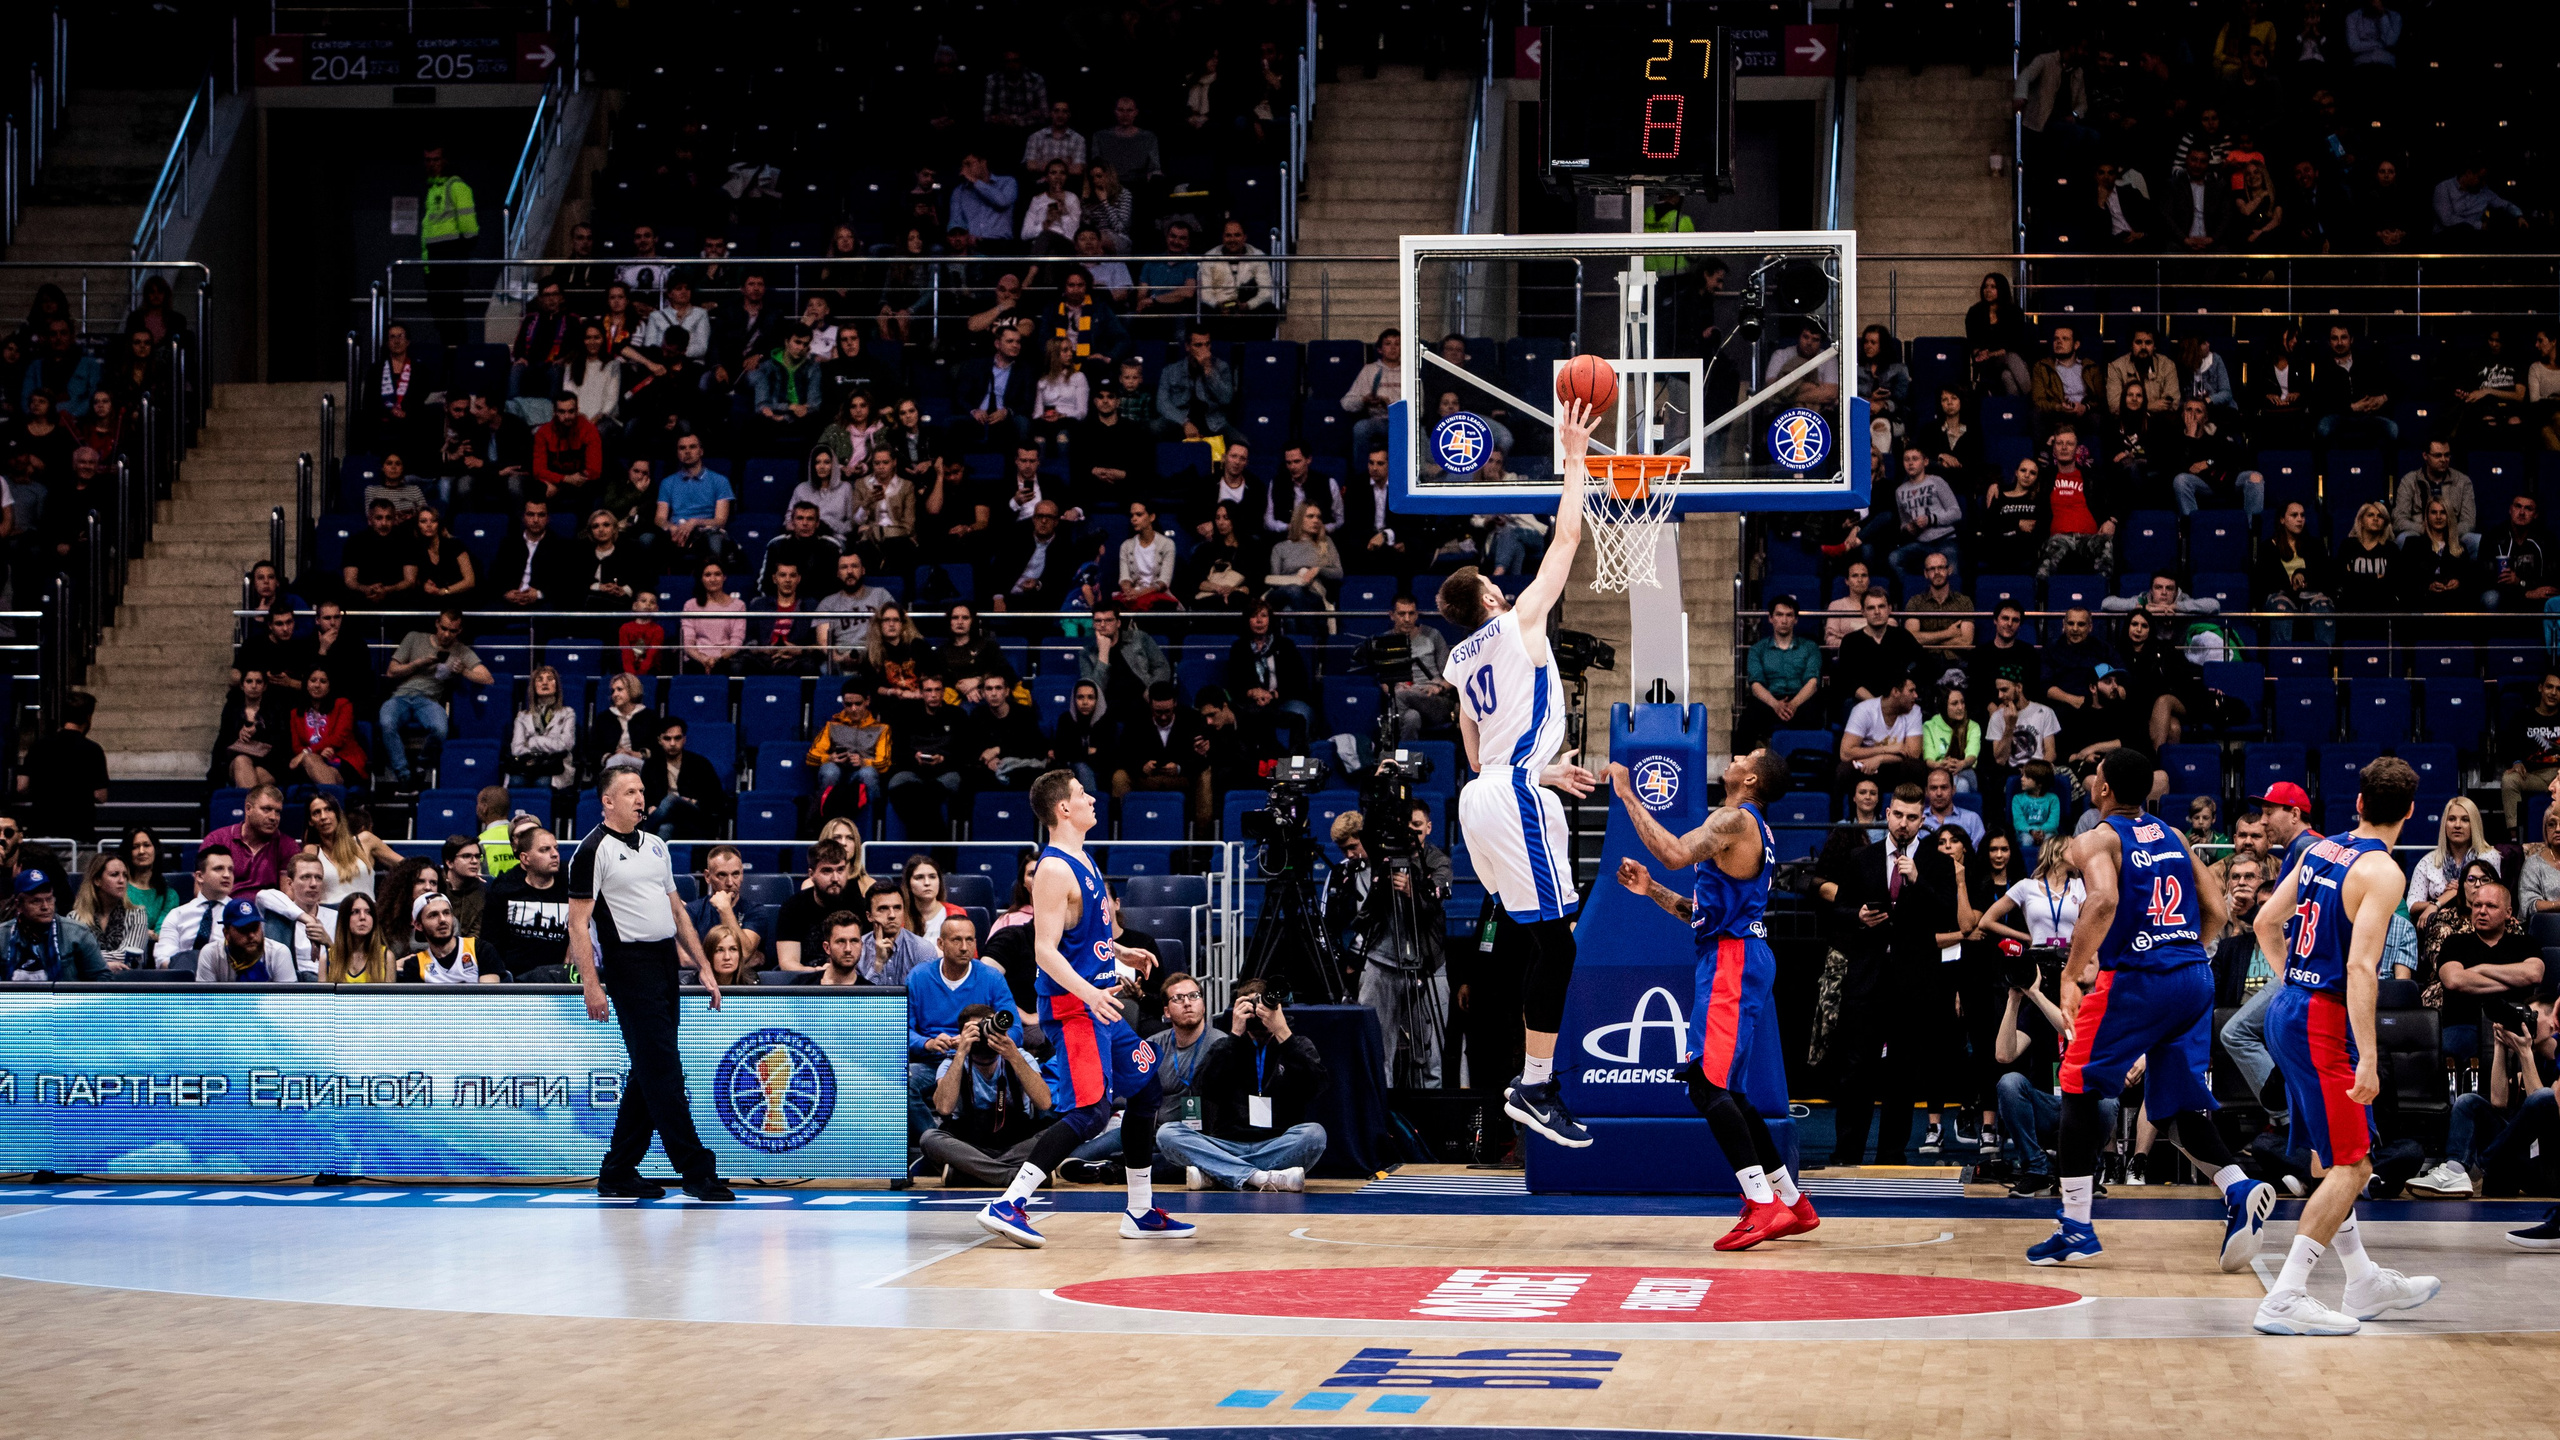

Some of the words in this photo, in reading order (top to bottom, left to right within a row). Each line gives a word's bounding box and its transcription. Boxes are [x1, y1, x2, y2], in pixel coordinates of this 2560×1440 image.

[310, 54, 368, 80] 204
[416, 53, 475, 79] 205
[1744, 55, 1777, 66] 01-12
[1642, 94, 1684, 159] 8
[1452, 619, 1502, 665] ESYATOV
[1465, 664, 1498, 723] 10
[493, 853, 514, 862] STEW
[2146, 875, 2187, 926] 42
[2295, 898, 2321, 958] 13
[1132, 1040, 1157, 1074] 30
[36, 1073, 229, 1107] ПАРТНЕР
[1318, 1347, 1622, 1390] ВТБ
